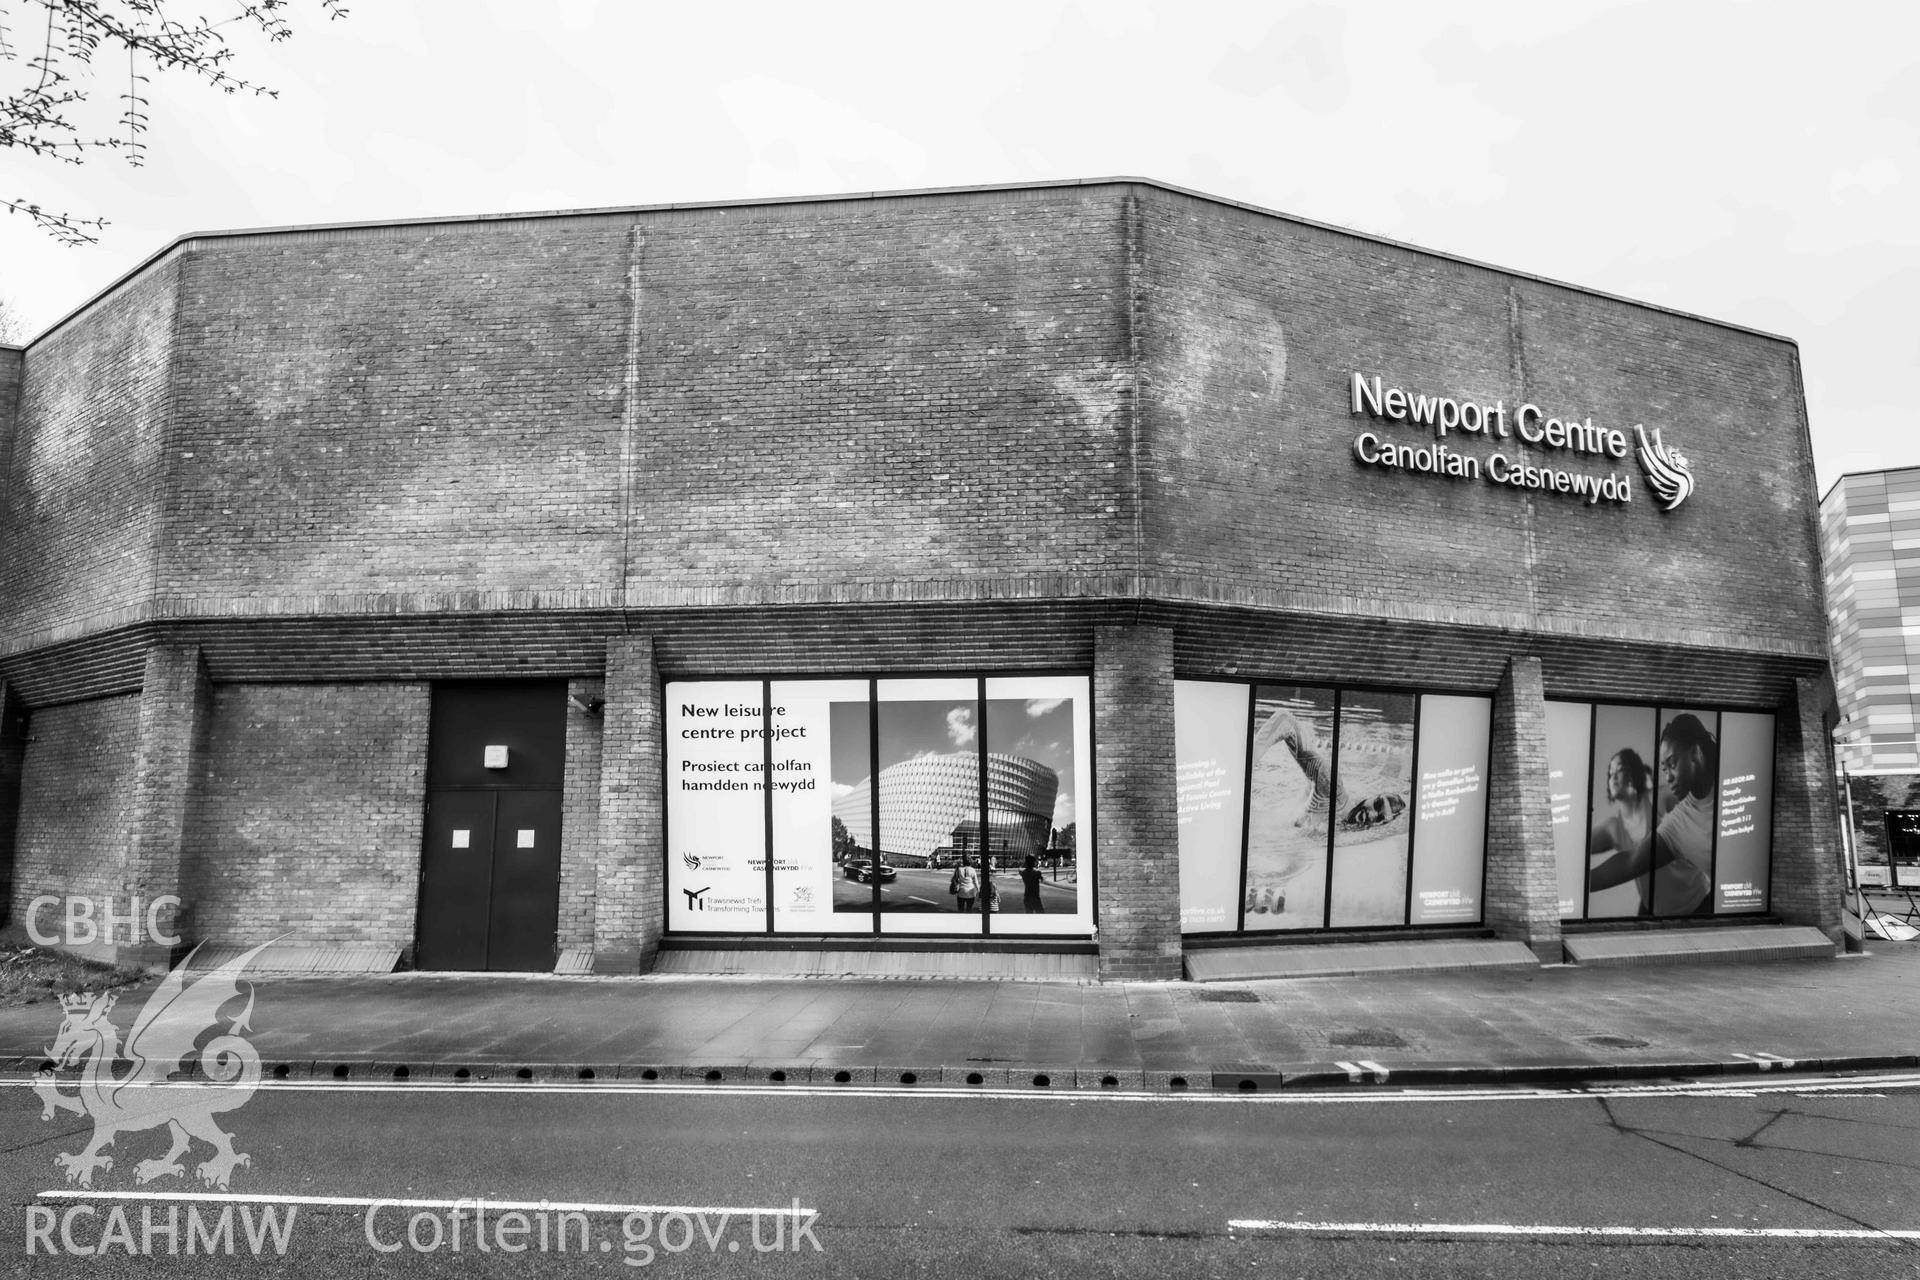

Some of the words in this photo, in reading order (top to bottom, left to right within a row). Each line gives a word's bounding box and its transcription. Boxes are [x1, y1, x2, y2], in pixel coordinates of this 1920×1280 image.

[1352, 372, 1508, 437] Newport
[1513, 404, 1627, 458] Centre
[1355, 432, 1479, 478] Canolfan
[1486, 454, 1632, 503] Casnewydd
[682, 704, 719, 717] New
[681, 727, 735, 739] centre
[682, 760, 740, 772] Prosiect
[682, 779, 748, 791] hamdden
[707, 905, 750, 913] Transforming
